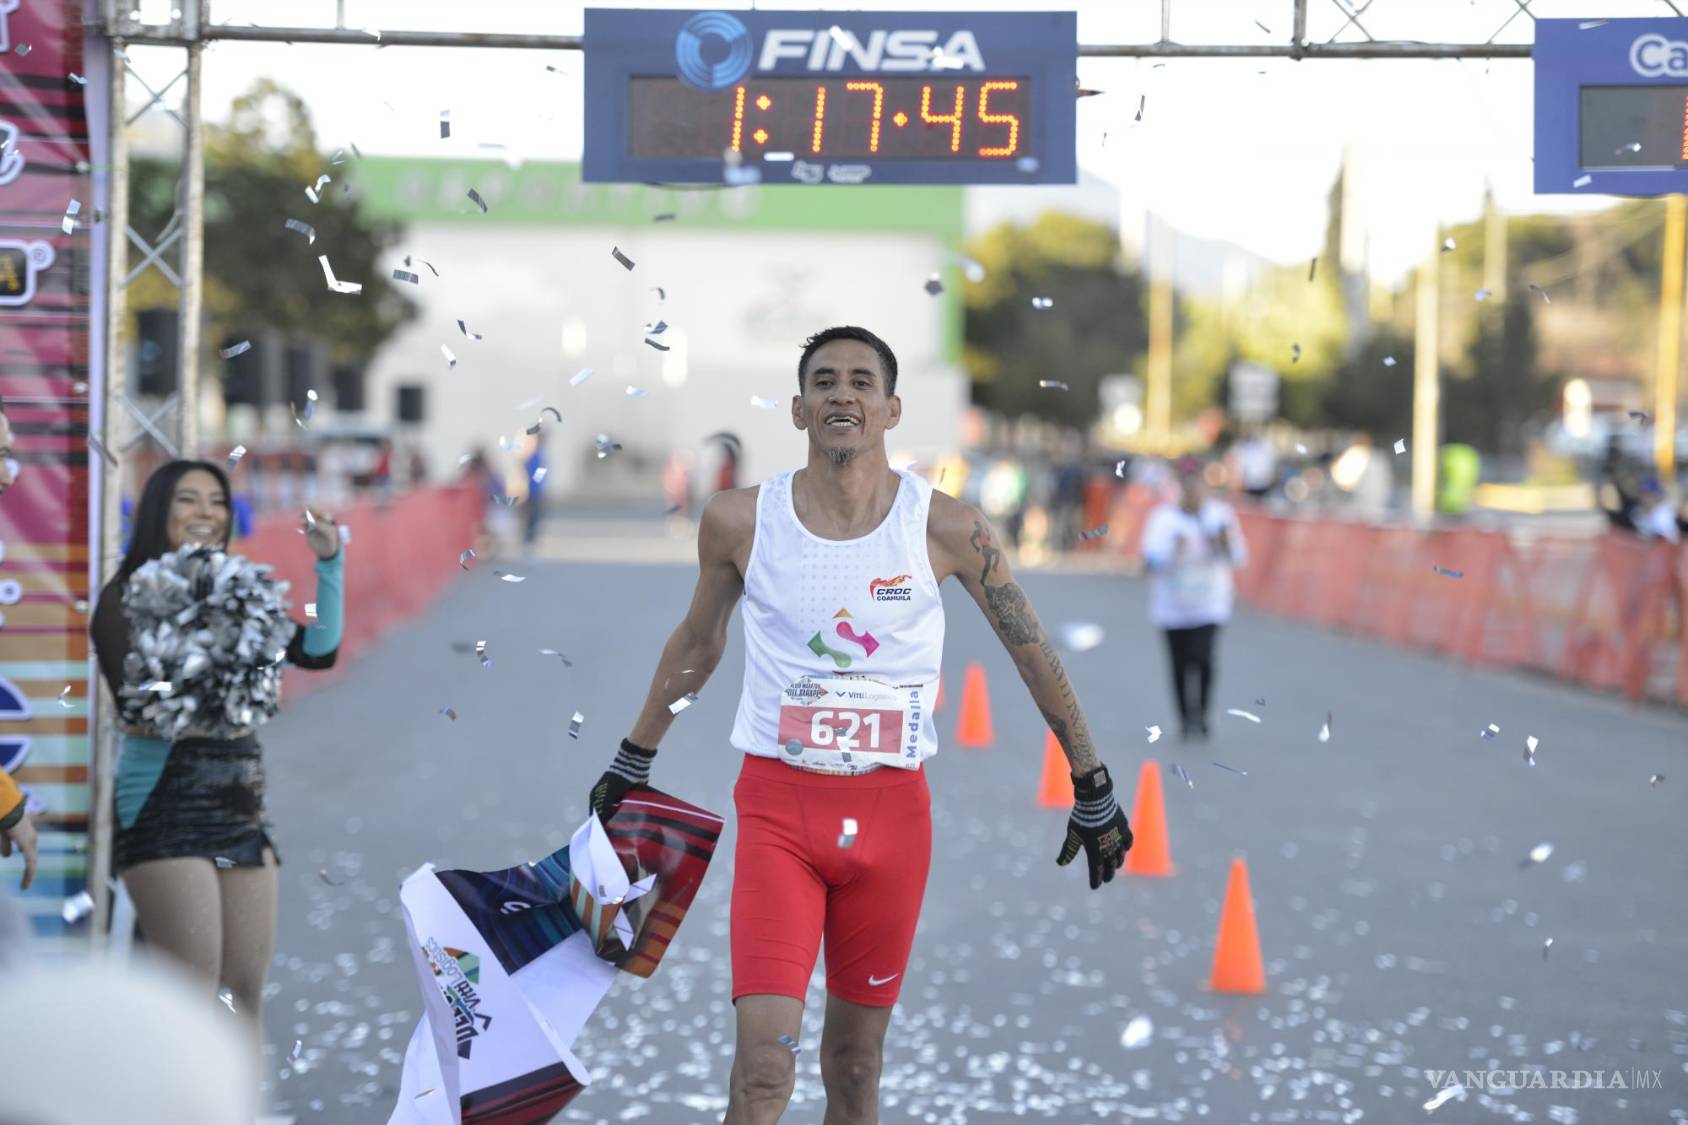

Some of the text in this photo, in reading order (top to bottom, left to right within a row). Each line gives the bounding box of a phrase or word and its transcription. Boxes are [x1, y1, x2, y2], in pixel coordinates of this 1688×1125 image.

[758, 29, 986, 72] FINSA
[811, 710, 881, 749] 621
[906, 691, 921, 758] Medalla
